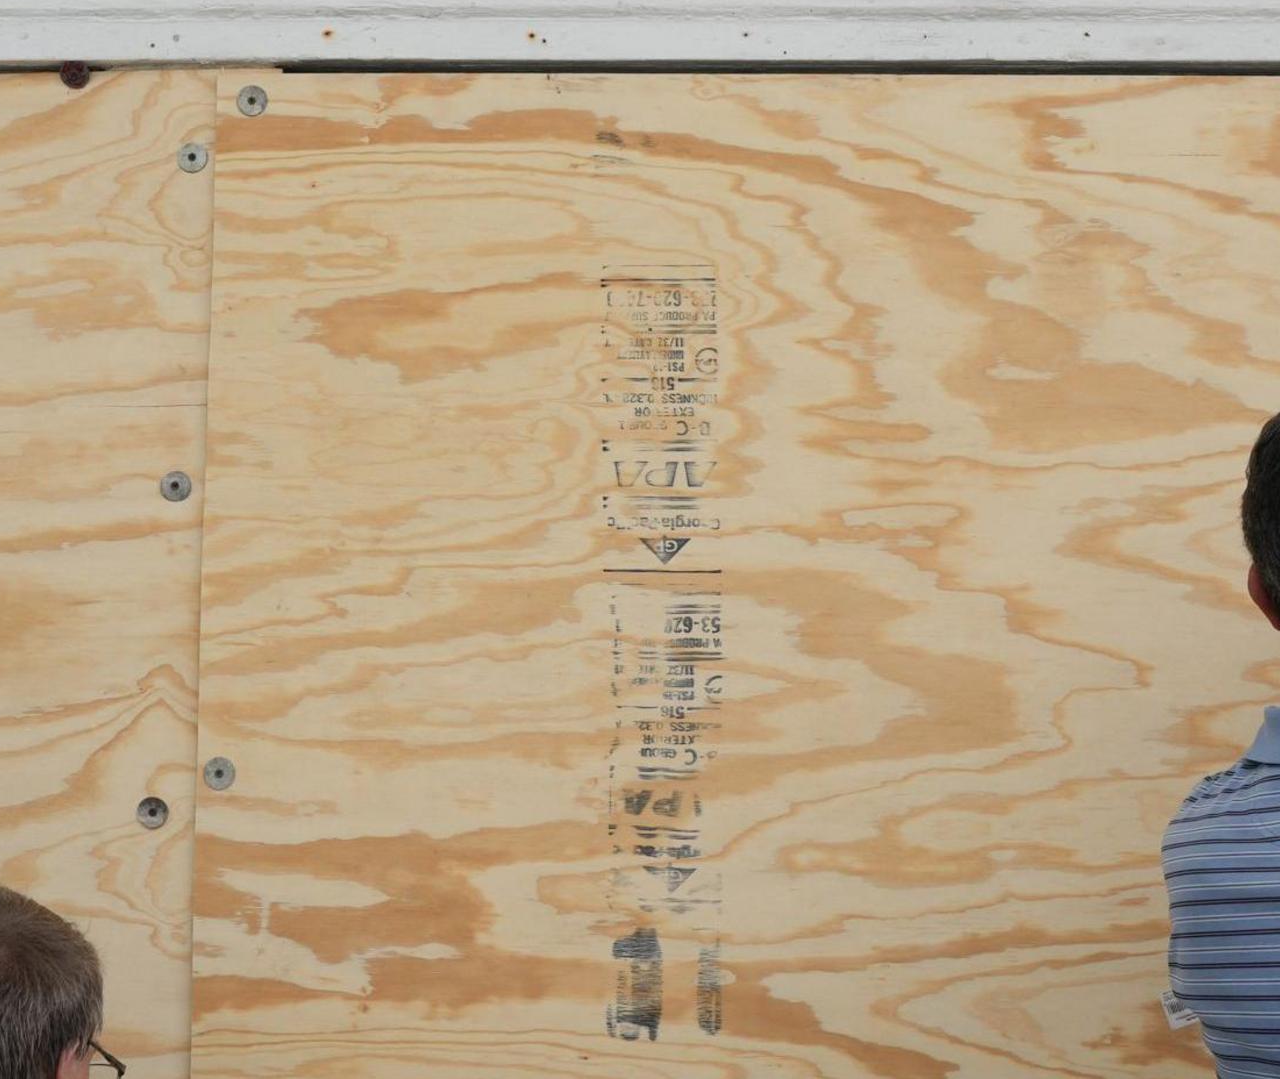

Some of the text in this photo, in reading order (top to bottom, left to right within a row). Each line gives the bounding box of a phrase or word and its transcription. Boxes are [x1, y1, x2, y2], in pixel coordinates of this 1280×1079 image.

[613, 461, 717, 488] APA
[660, 706, 685, 719] 516
[622, 789, 702, 817] PA
